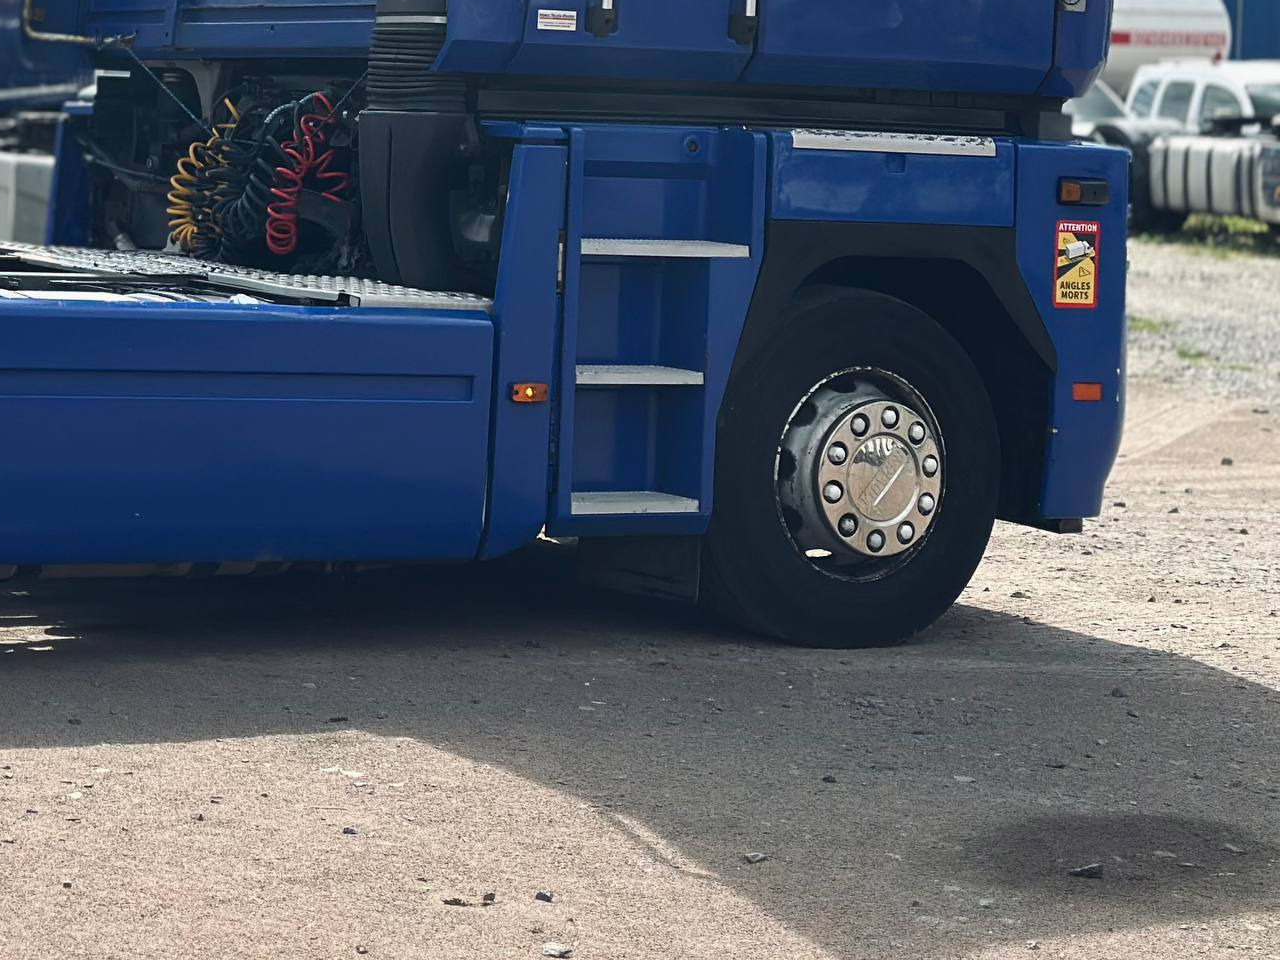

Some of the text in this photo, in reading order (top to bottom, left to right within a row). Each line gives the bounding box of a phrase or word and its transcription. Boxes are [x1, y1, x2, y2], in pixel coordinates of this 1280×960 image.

[1059, 223, 1097, 232] ATTENTION
[1060, 281, 1091, 290] ANGLES
[1061, 290, 1089, 300] MORTS
